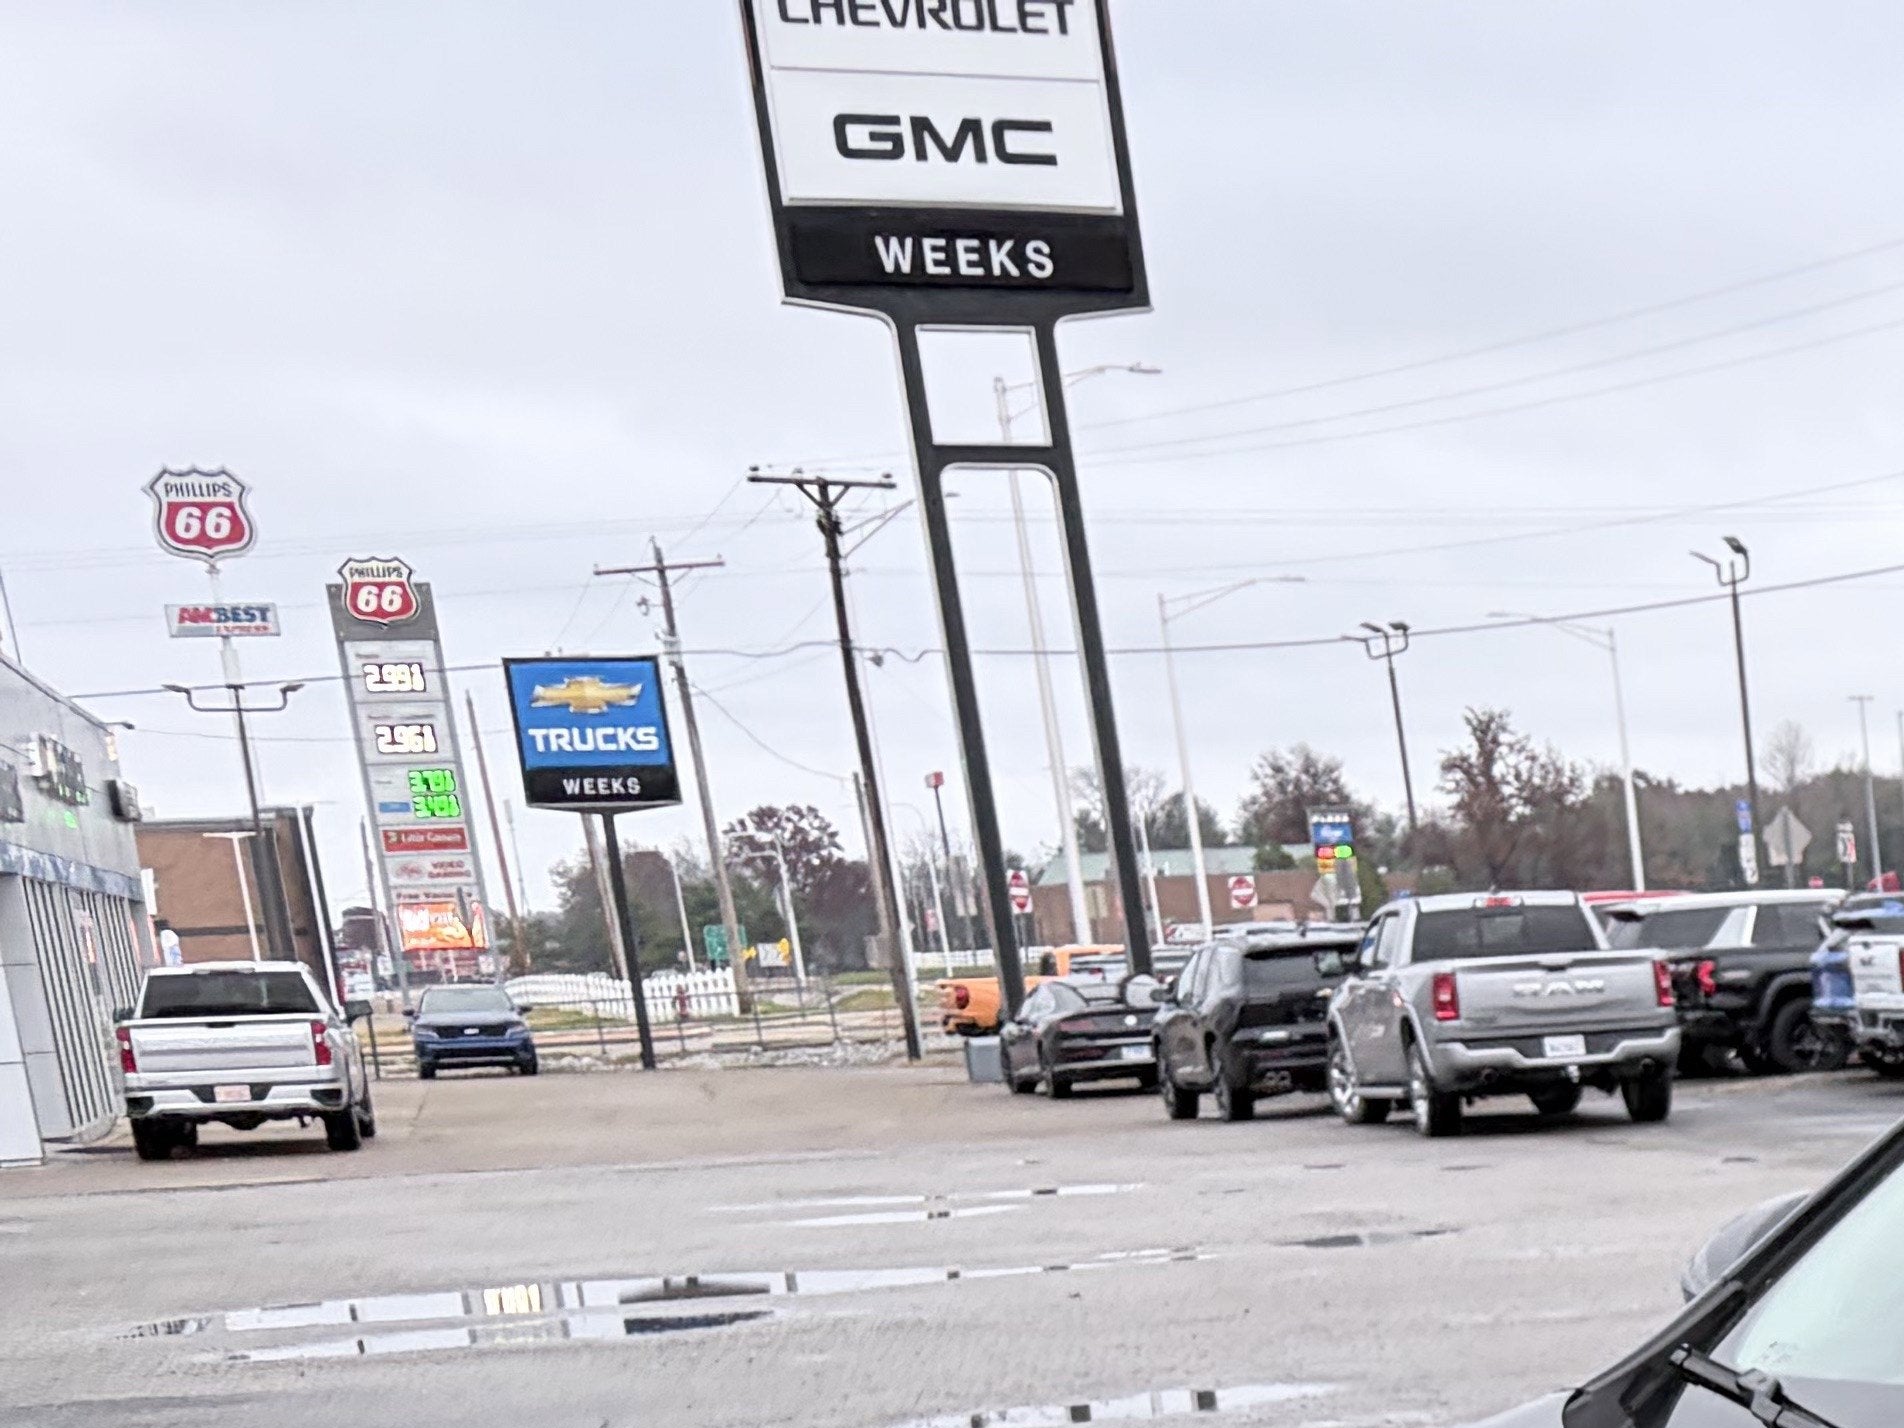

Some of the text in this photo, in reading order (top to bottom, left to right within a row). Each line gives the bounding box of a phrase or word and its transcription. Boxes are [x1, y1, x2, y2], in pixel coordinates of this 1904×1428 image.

[779, 0, 1075, 36] CHEVROLET
[833, 112, 1058, 166] GMC
[874, 234, 1055, 279] WEEKS
[164, 481, 234, 498] PHILLIPS
[174, 506, 233, 540] 66
[350, 566, 404, 579] PHILLIPS
[356, 585, 404, 613] 66
[528, 727, 659, 752] TRUCKS
[563, 777, 641, 795] WEEKS
